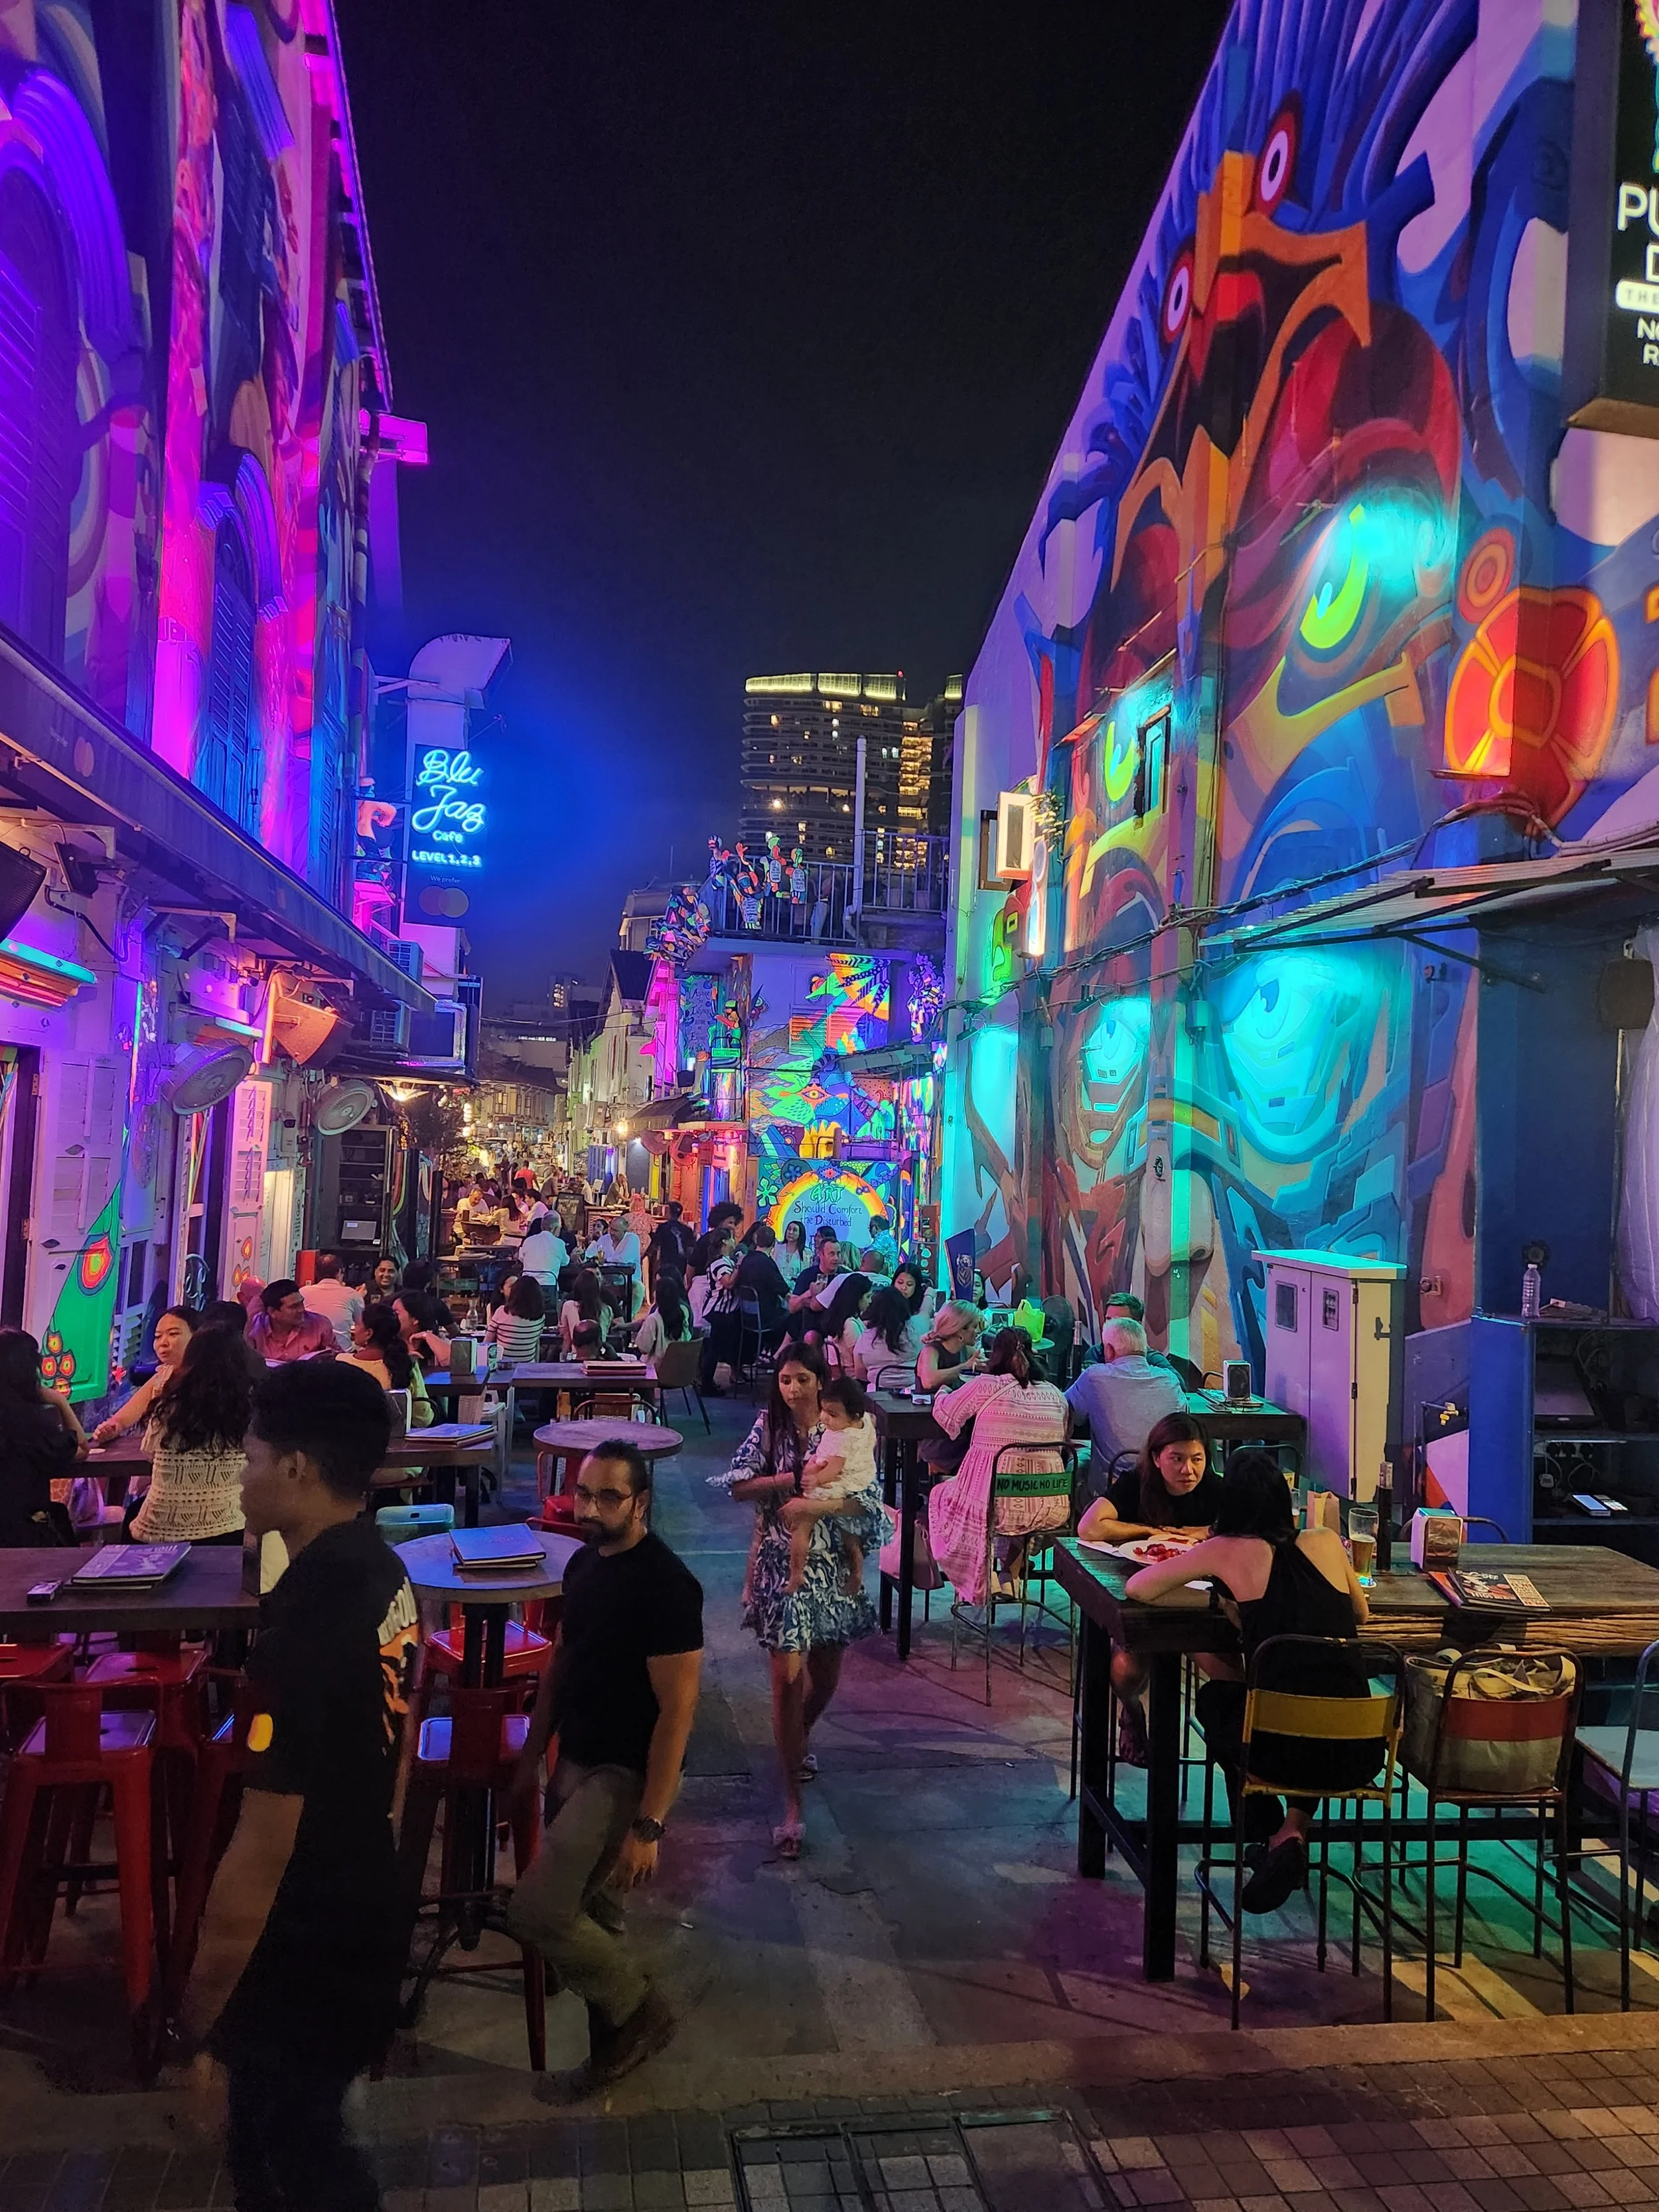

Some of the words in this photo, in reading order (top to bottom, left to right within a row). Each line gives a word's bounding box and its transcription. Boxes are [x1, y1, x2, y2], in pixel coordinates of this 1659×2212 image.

[415, 749, 484, 786] Blu
[411, 784, 487, 833] Jaz
[433, 830, 463, 844] Cafe
[412, 849, 447, 863] LEVEL
[794, 1201, 826, 1214] Should
[829, 1203, 863, 1216] Comfort
[814, 1215, 852, 1227] Disturbed
[997, 1478, 1009, 1491] NO
[1011, 1479, 1039, 1491] MUSIC
[1039, 1479, 1050, 1489] NO
[1052, 1478, 1068, 1489] LIFE
